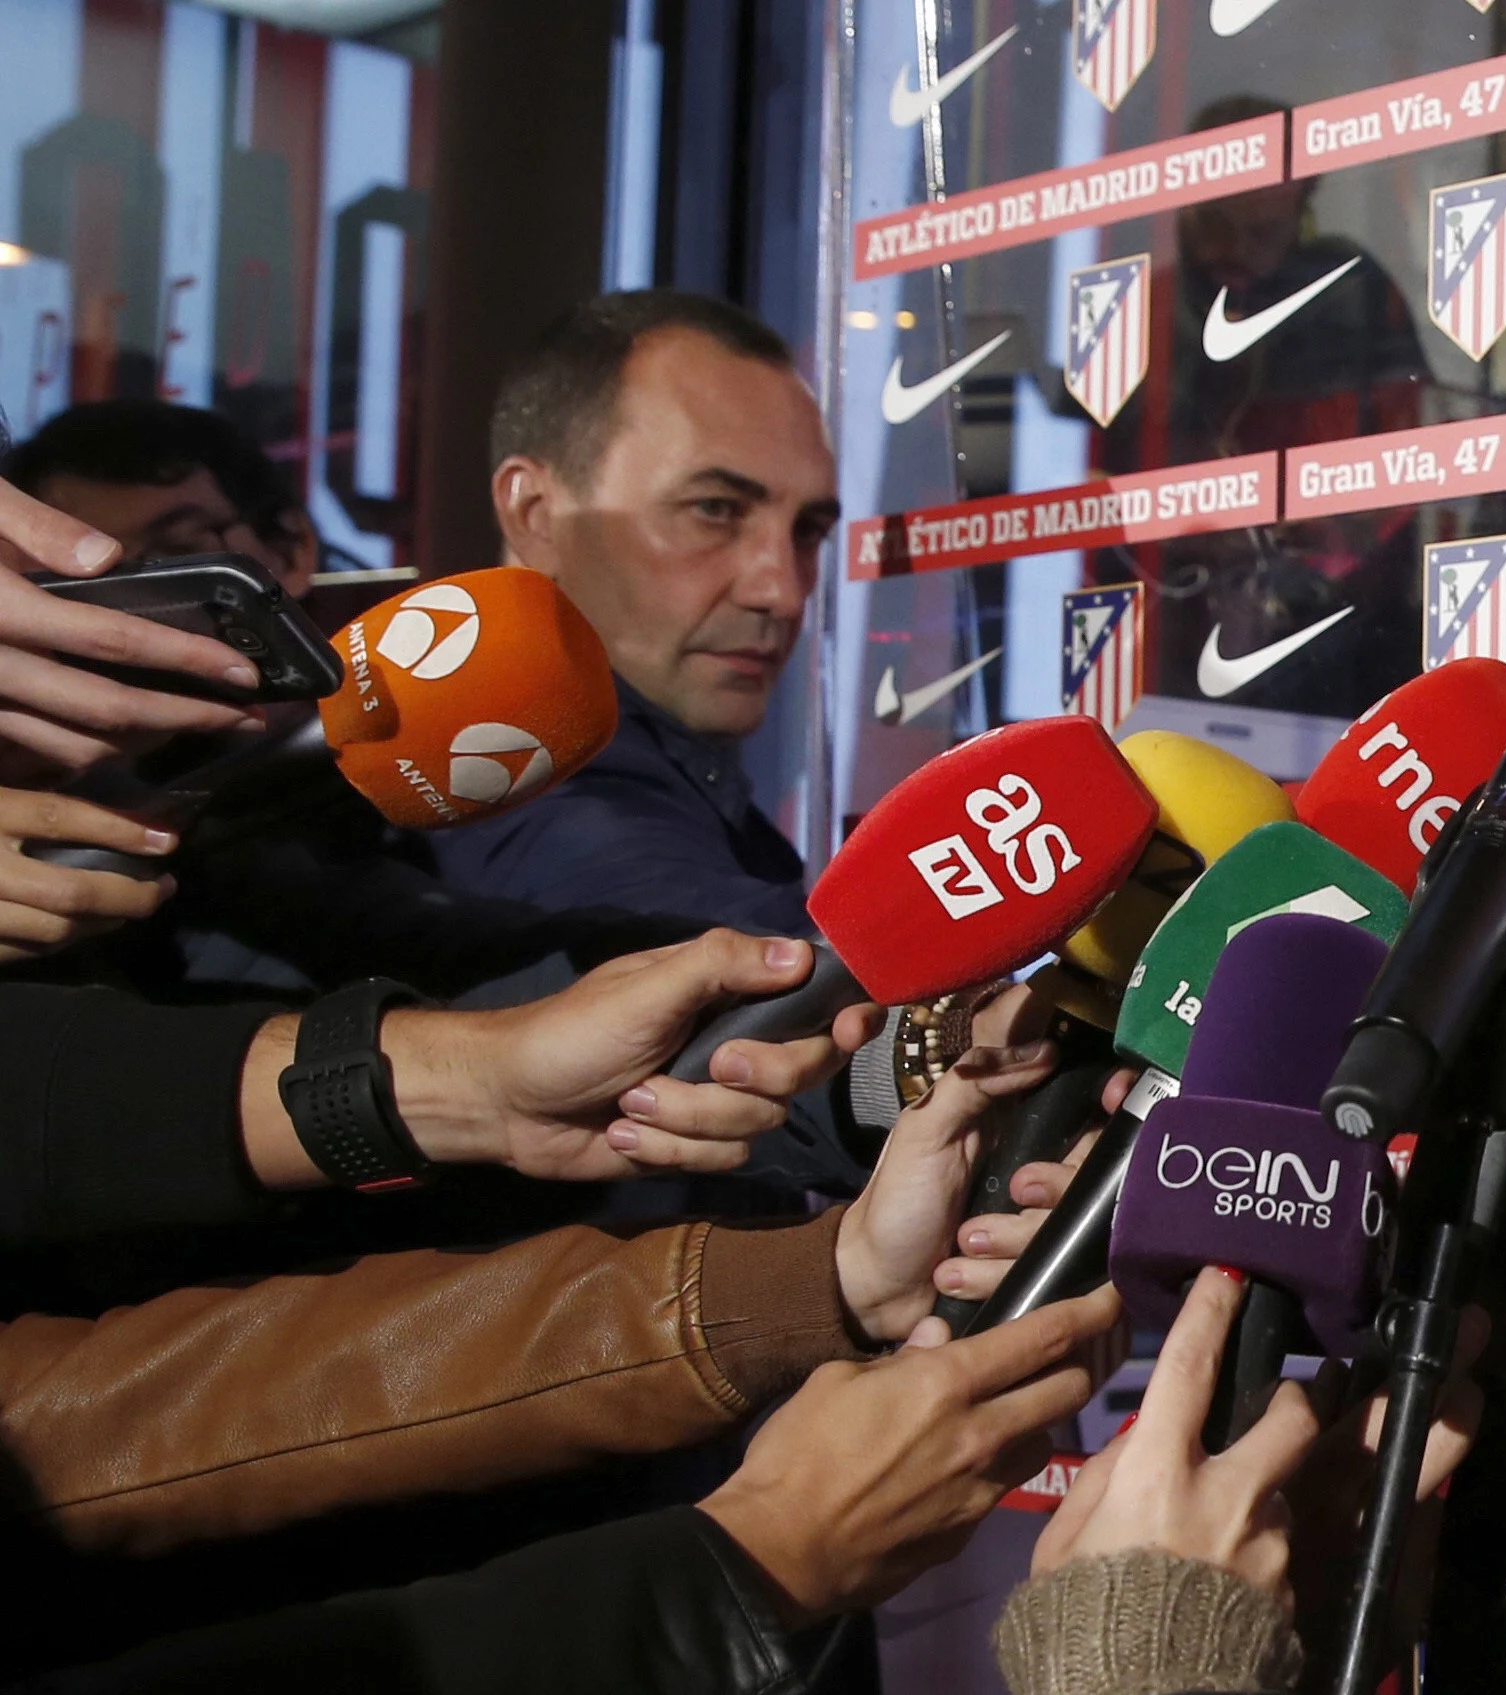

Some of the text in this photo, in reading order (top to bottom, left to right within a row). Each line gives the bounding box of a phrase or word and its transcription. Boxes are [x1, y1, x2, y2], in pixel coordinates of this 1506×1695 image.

[1305, 110, 1383, 157] Gran
[1386, 91, 1452, 132] Vía,
[864, 132, 1267, 265] ATLÉTICO DE MADRID STORE
[1299, 460, 1376, 499] Gran
[1380, 443, 1447, 487] Vía,
[1453, 434, 1501, 476] 47
[991, 507, 1030, 544] DE
[1034, 486, 1153, 539] MADRID
[1156, 470, 1261, 521] STORE
[348, 620, 379, 713] ANTENA 3
[965, 773, 1082, 896] as
[1213, 1191, 1333, 1230] SPORTS
